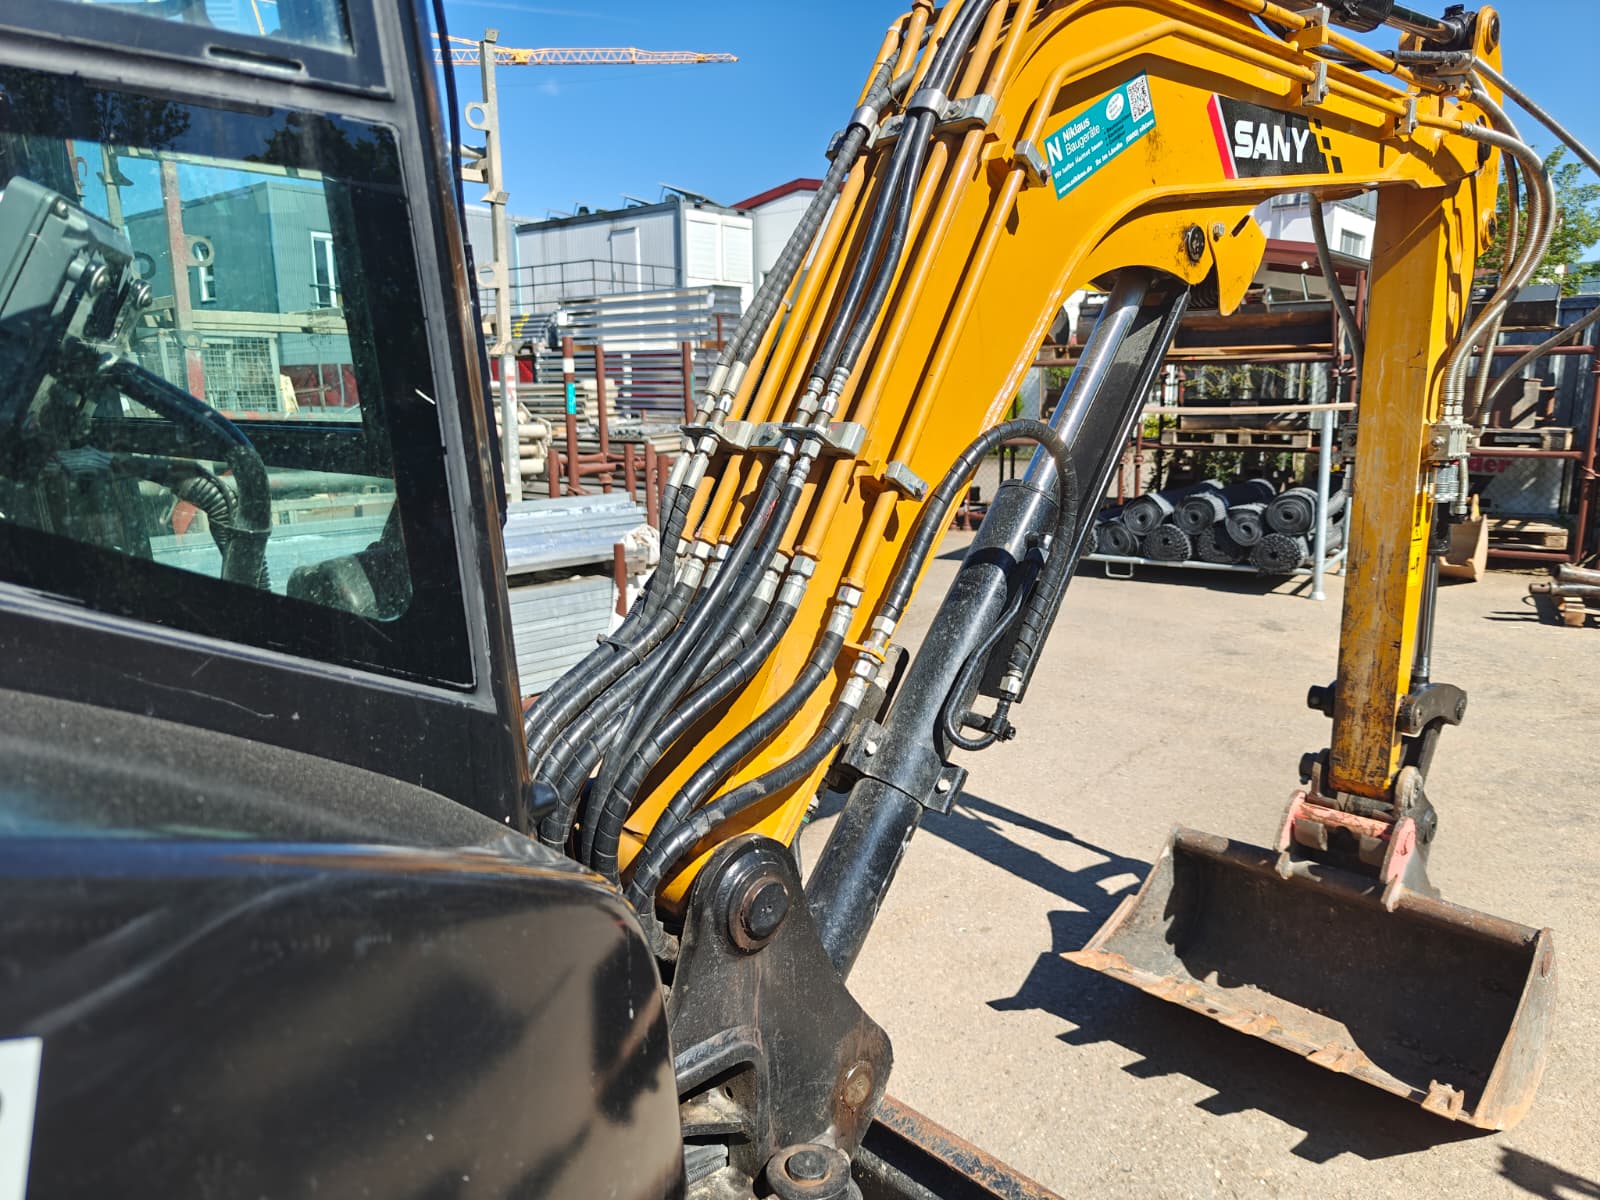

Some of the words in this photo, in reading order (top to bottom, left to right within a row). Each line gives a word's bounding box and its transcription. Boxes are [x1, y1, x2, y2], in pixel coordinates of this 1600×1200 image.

[1062, 118, 1090, 143] Niklaus
[1065, 125, 1100, 156] Baugeräte
[1234, 120, 1310, 163] SANY
[1046, 136, 1063, 167] N
